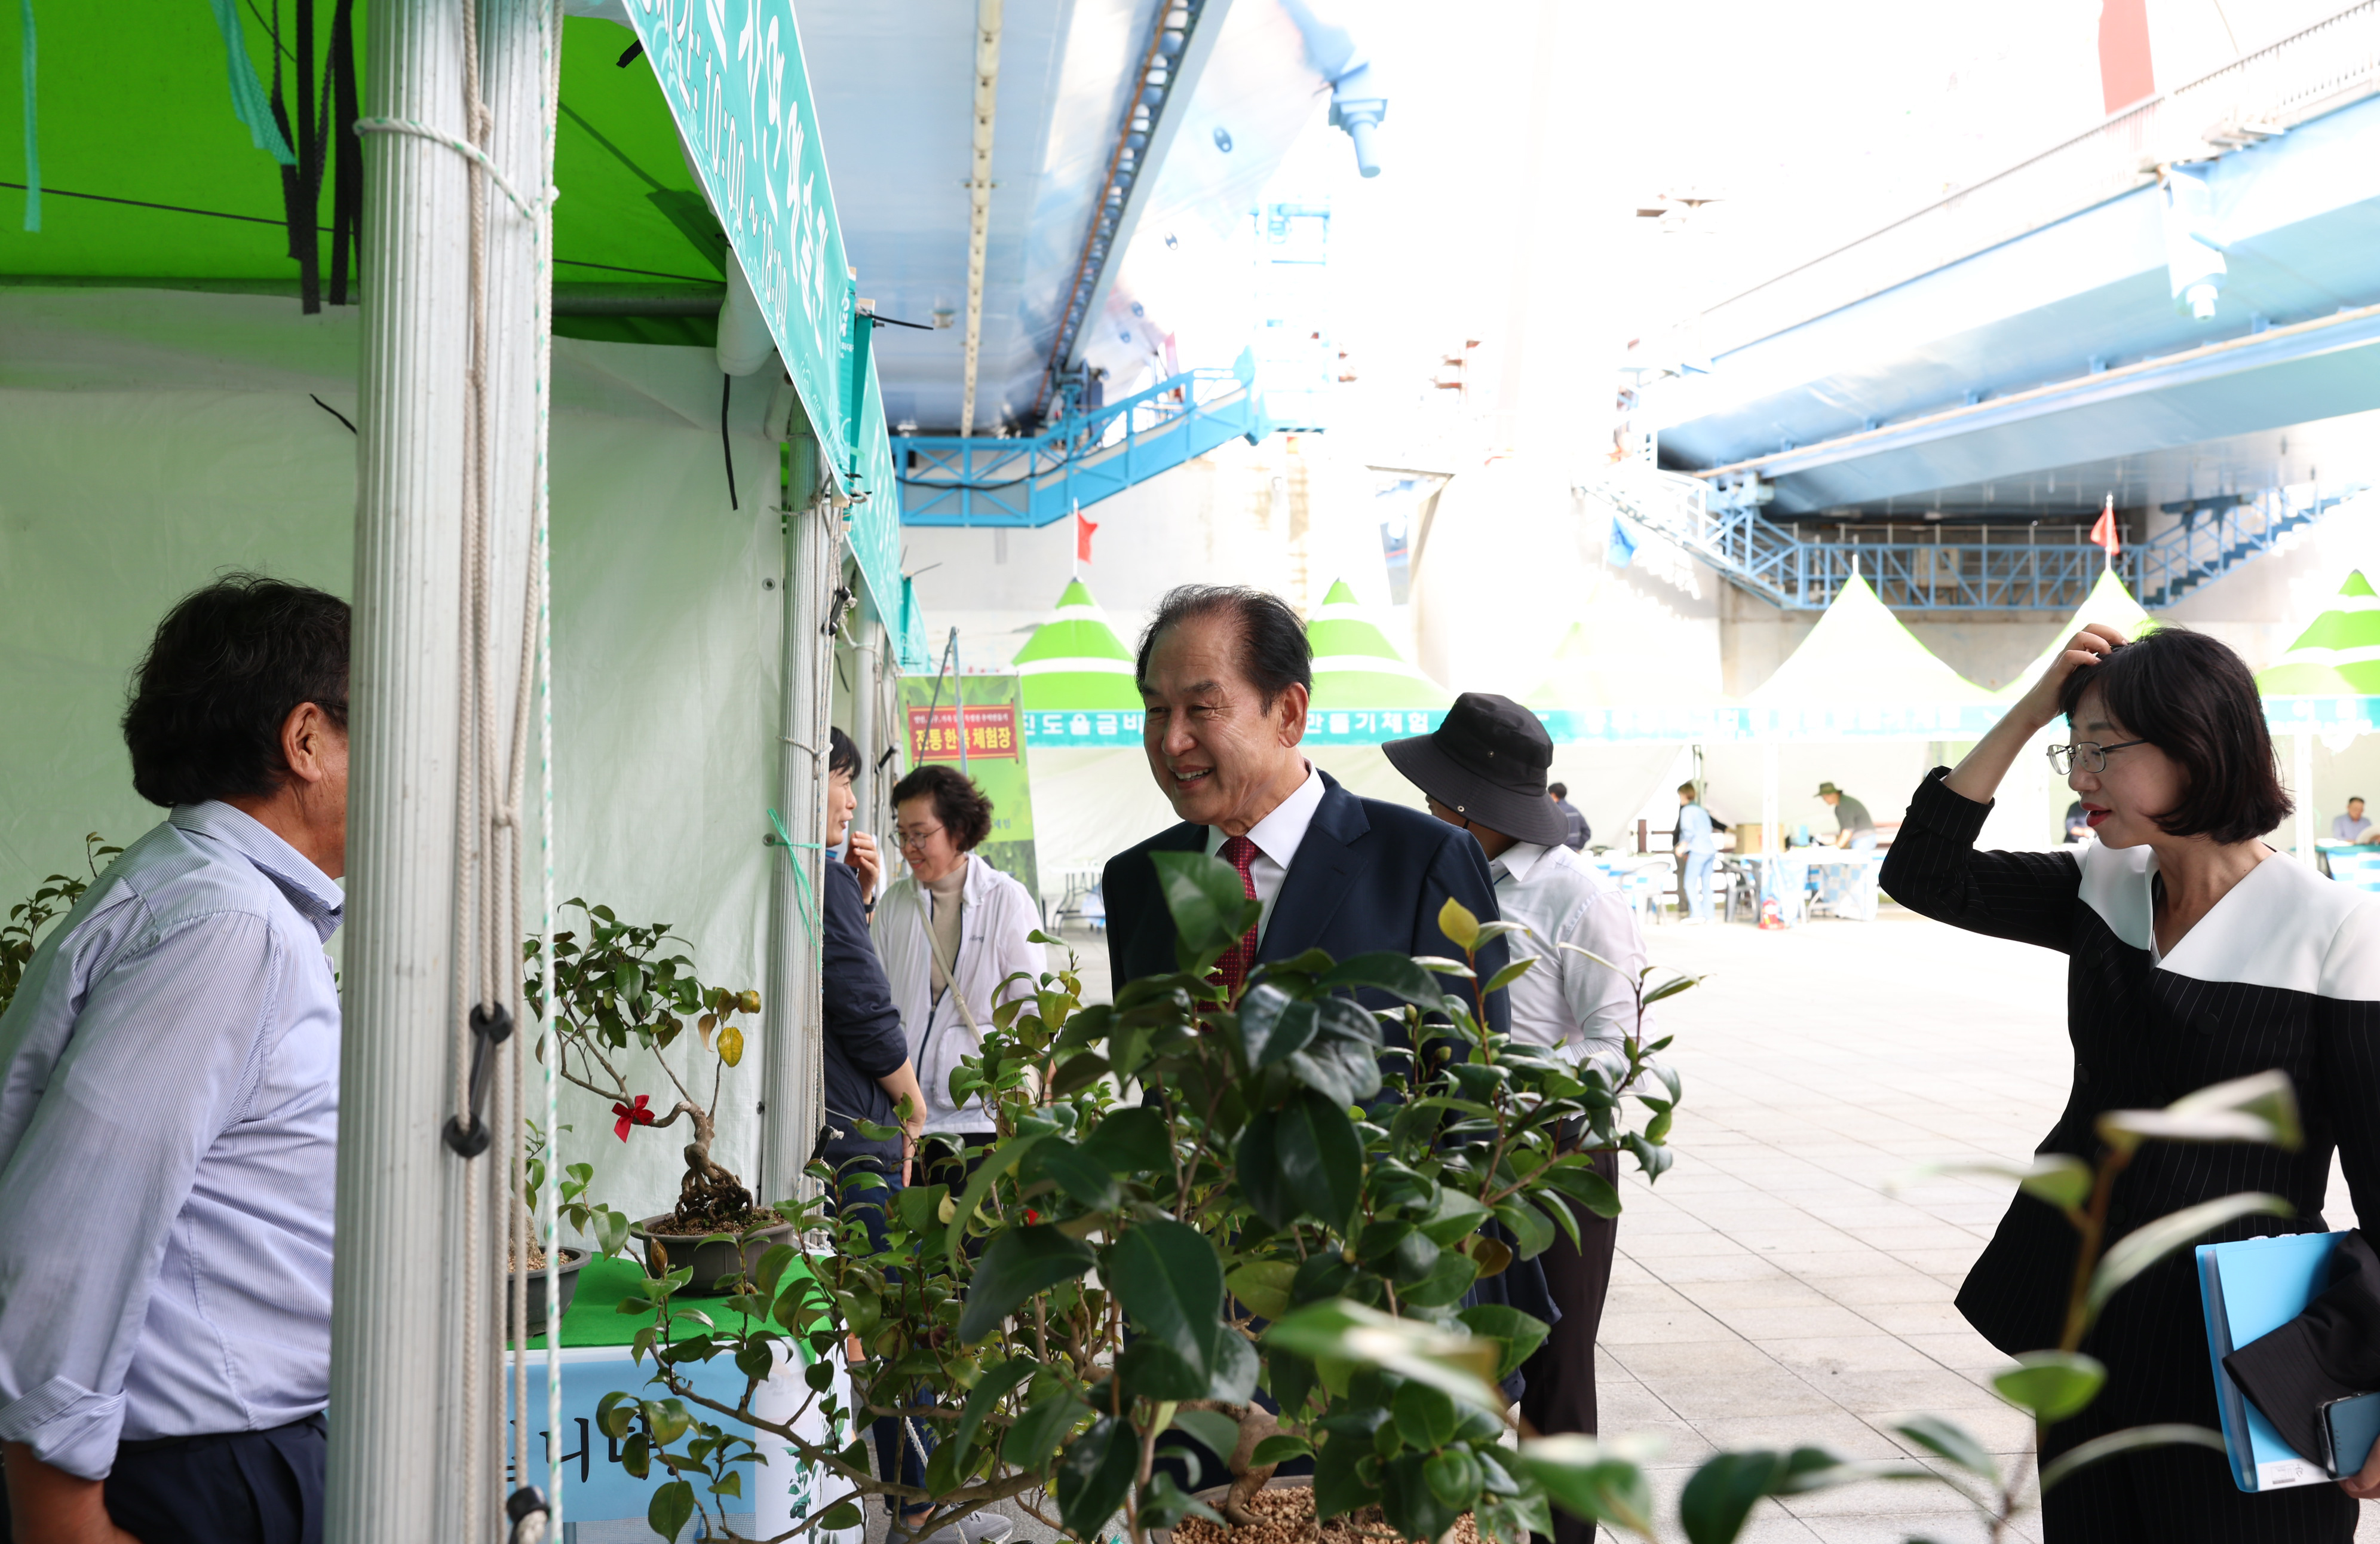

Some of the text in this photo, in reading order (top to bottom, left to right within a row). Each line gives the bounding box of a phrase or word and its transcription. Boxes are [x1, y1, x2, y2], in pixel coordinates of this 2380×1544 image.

[641, 0, 701, 113] 시간:
[704, 48, 745, 234] 10:00
[762, 209, 788, 340] 18:00
[916, 728, 942, 751] 전통
[972, 727, 1011, 749] 체험장
[1305, 712, 1428, 734] 만들기체험
[507, 1414, 679, 1484] 니다.
